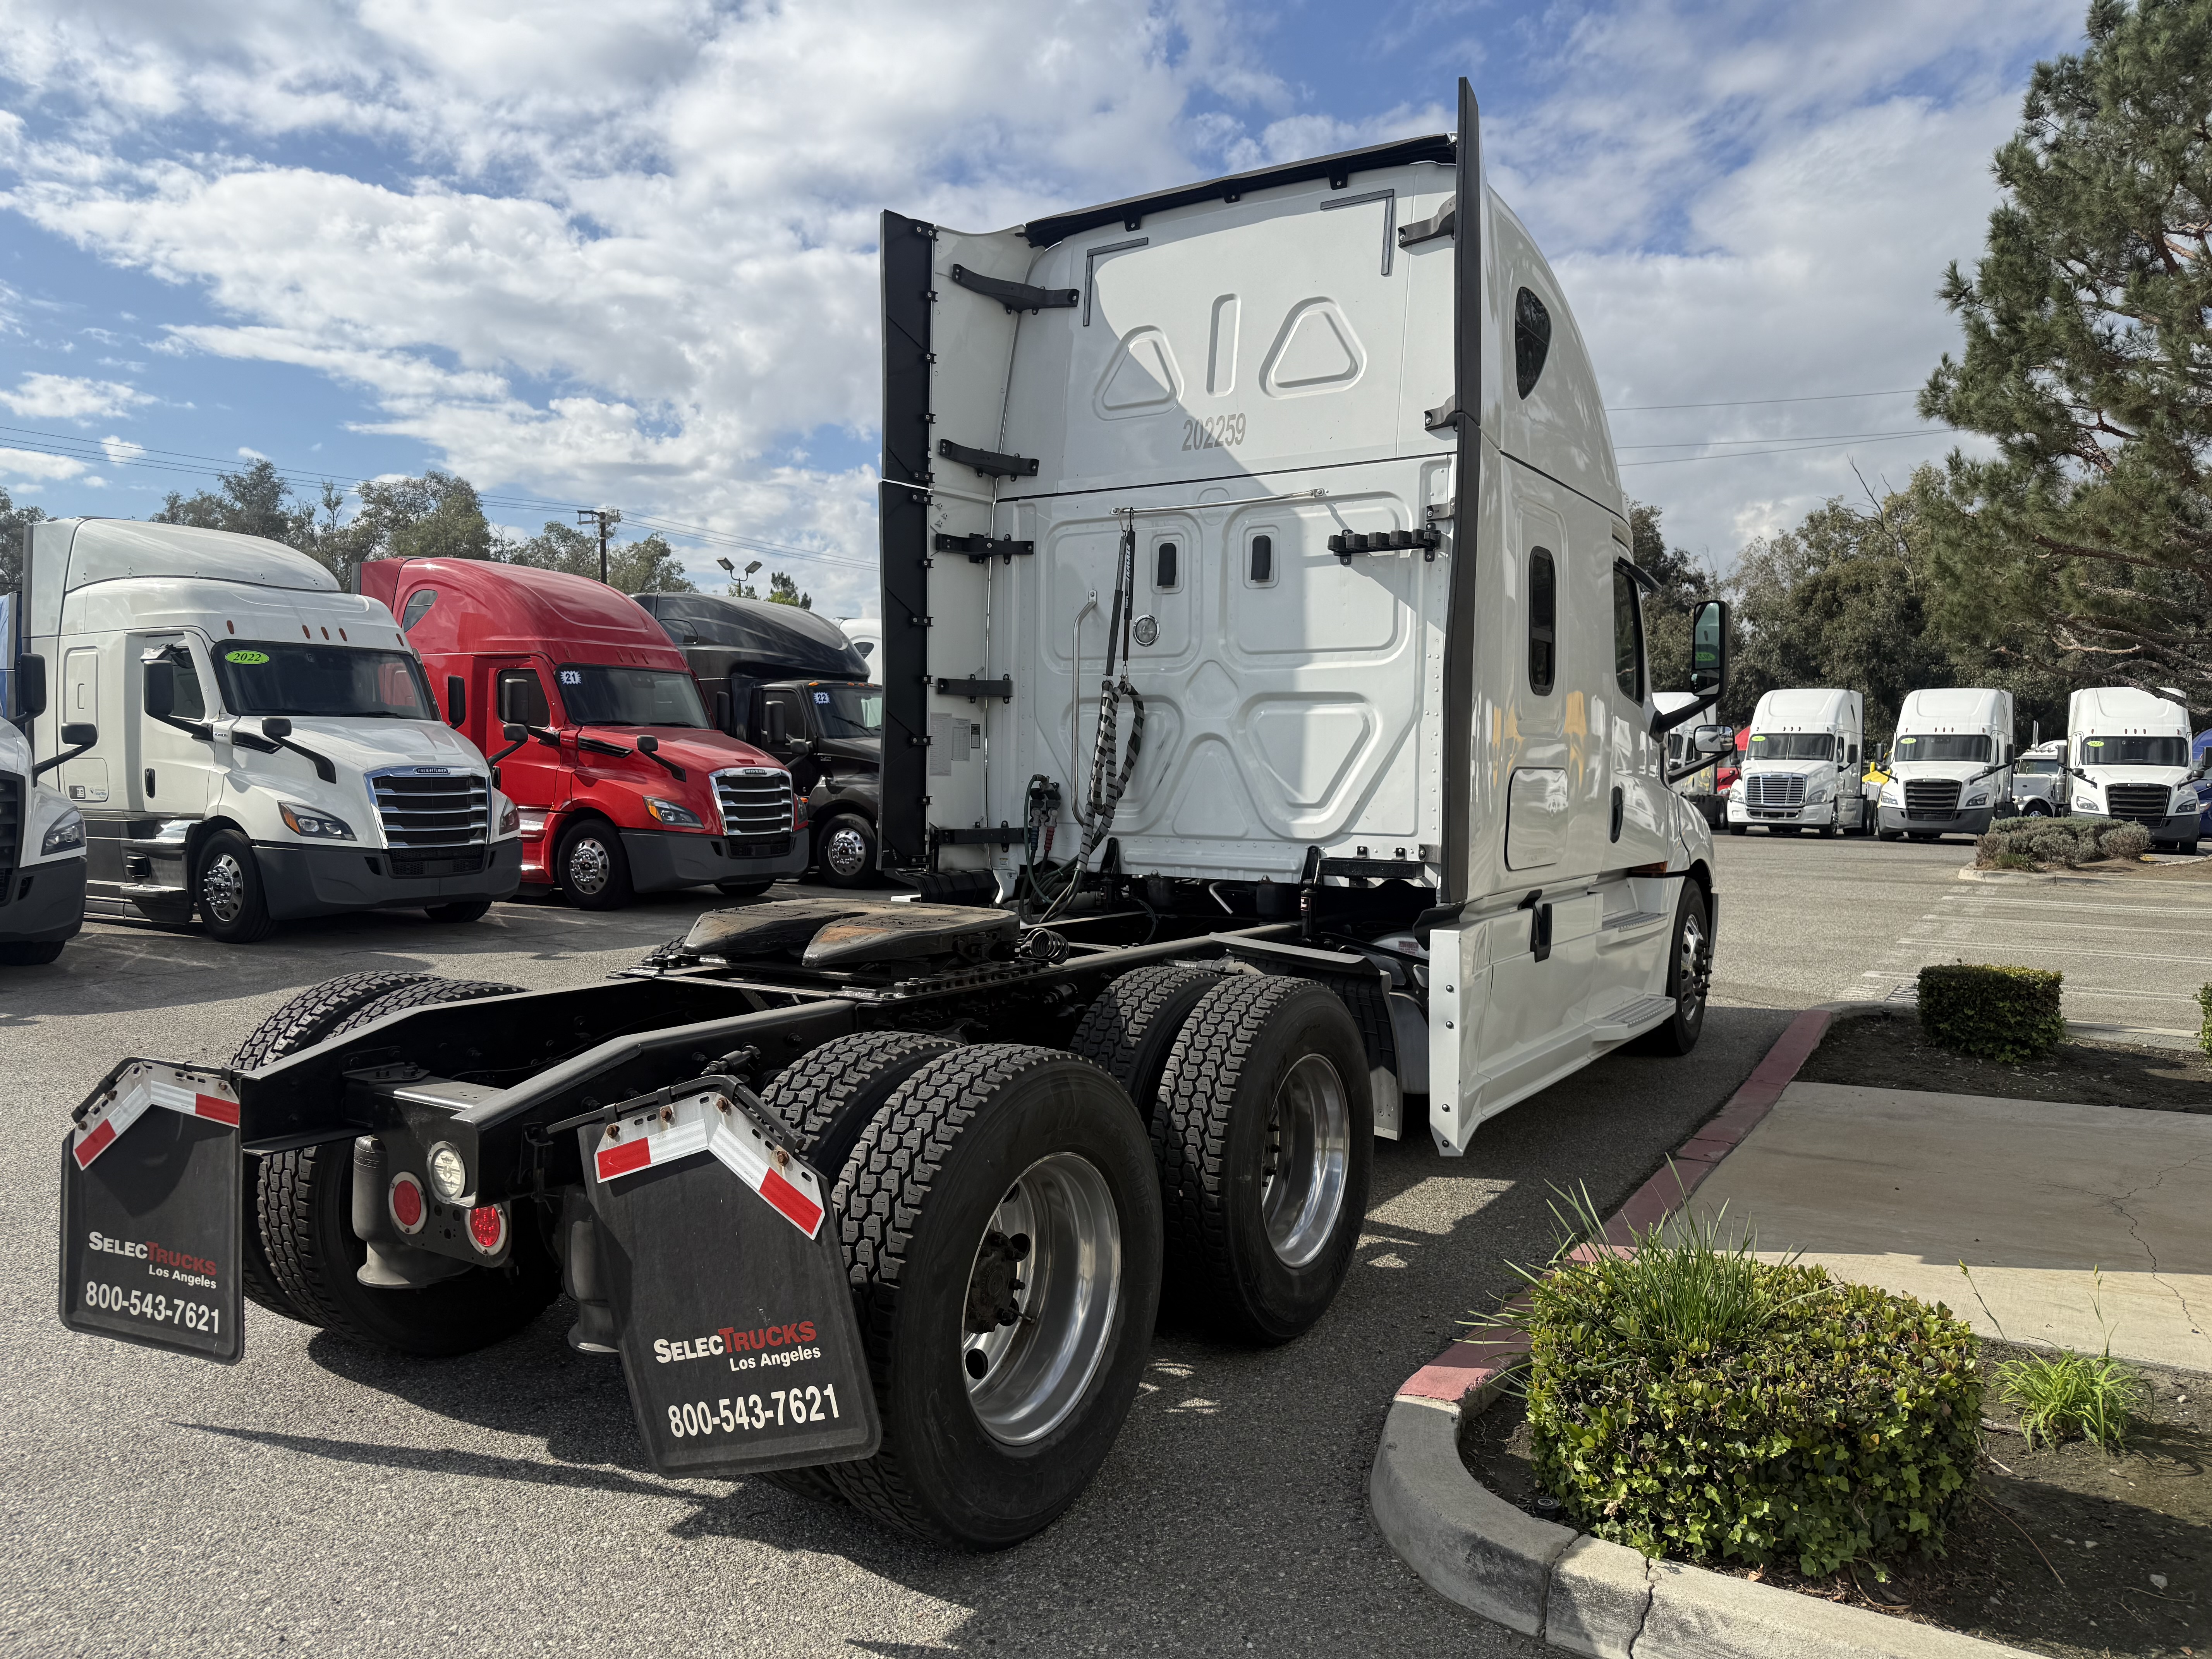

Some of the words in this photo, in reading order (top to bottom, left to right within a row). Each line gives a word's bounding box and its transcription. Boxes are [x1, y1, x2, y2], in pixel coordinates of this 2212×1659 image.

[1182, 412, 1246, 451] 202259
[233, 653, 261, 661] 2022
[565, 673, 576, 682] 21
[149, 1264, 169, 1277] Los
[172, 1270, 216, 1289] Angeles
[86, 1281, 219, 1334] 800-543-7621
[730, 1358, 756, 1372] Los
[760, 1345, 821, 1367] Angeles
[668, 1383, 839, 1437] 800-543-7621
